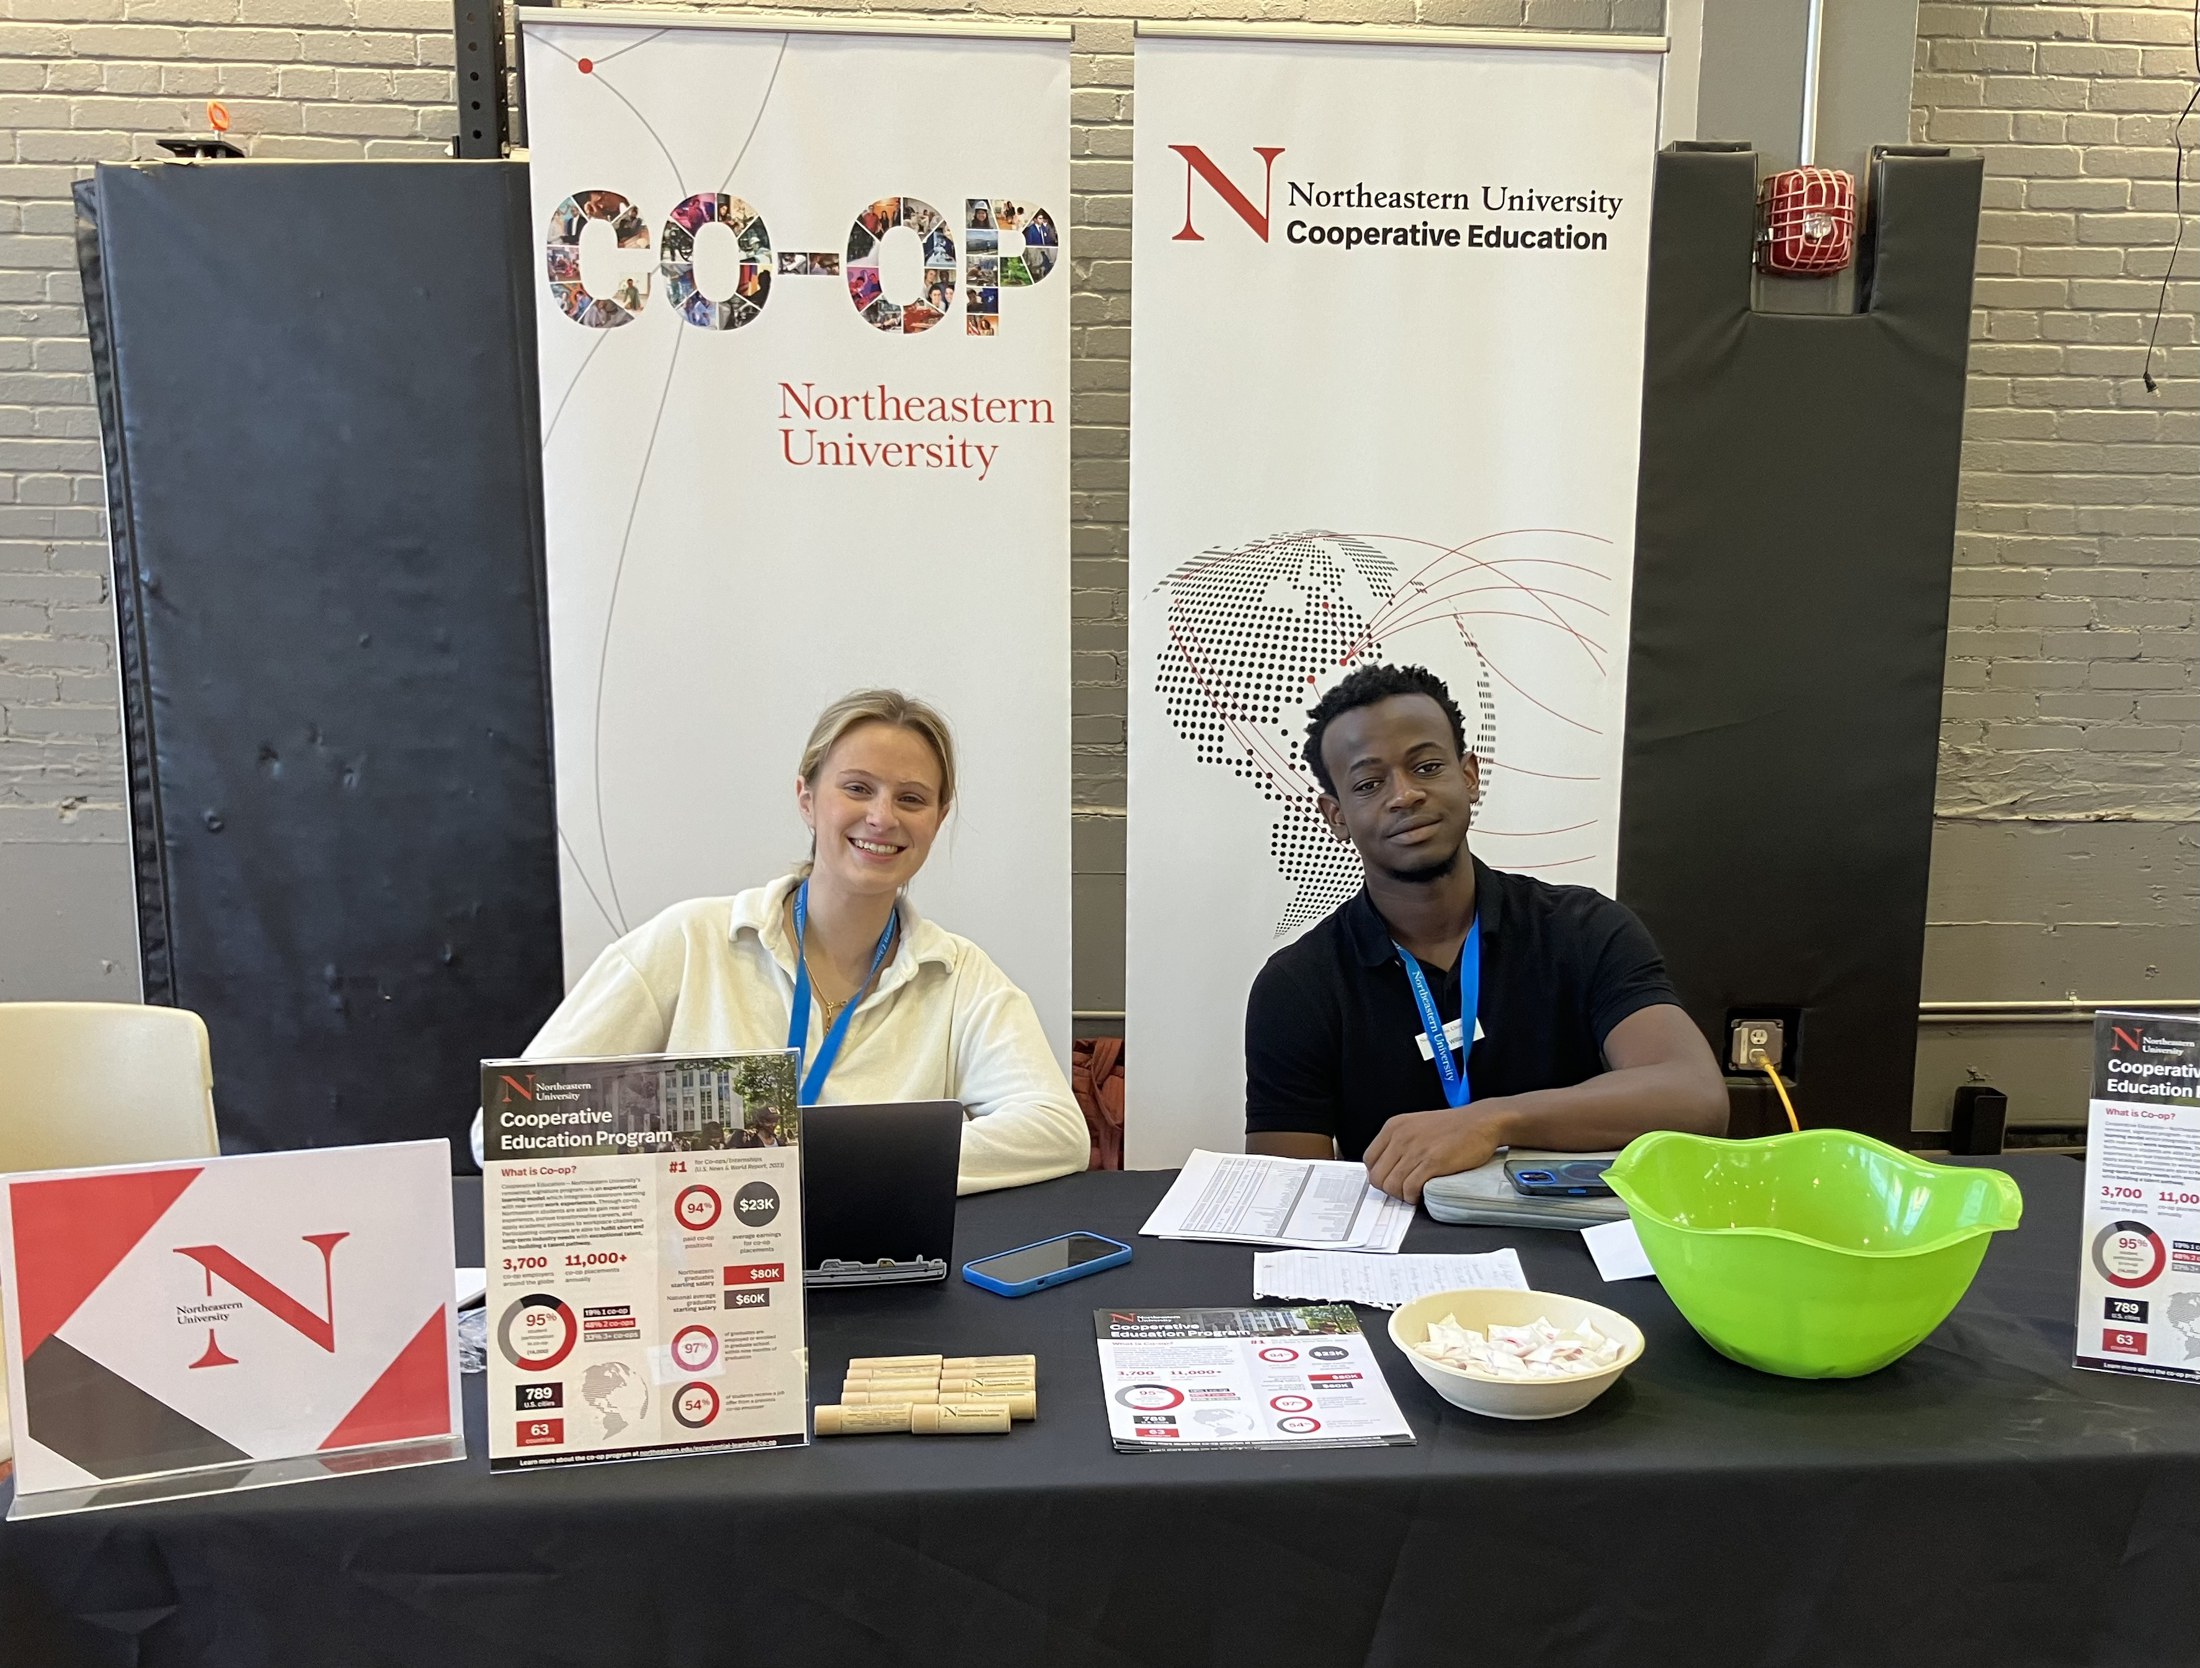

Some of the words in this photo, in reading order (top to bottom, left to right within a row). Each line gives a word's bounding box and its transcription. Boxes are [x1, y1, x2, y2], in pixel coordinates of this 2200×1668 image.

[1167, 144, 1286, 243] N
[1287, 181, 1469, 211] Northeastern
[1482, 186, 1624, 220] University
[1286, 220, 1461, 250] Cooperative
[1468, 224, 1607, 251] Education
[546, 190, 1059, 336] CO-OP
[777, 382, 1055, 424] Northeastern
[779, 428, 999, 482] University
[1412, 971, 1438, 1033] Northeastern
[1434, 1033, 1455, 1082] University
[2111, 1026, 2144, 1052] N
[2142, 1045, 2184, 1056] University
[500, 1074, 536, 1103] N
[536, 1082, 592, 1091] Northeastern
[2107, 1078, 2193, 1098] Education
[536, 1093, 580, 1102] University
[500, 1108, 613, 1129] Cooperative
[2106, 1108, 2129, 1116] What
[2131, 1109, 2139, 1117] is
[2141, 1111, 2176, 1121] Co-op?
[500, 1131, 593, 1150] Education
[596, 1130, 673, 1147] Program
[501, 1168, 527, 1177] What
[529, 1166, 538, 1176] is
[540, 1165, 577, 1176] Co-op?
[669, 1161, 687, 1173] #1
[2101, 1186, 2142, 1200] 3,700
[687, 1202, 712, 1214] 94%
[739, 1198, 775, 1213] $23K
[2119, 1237, 2148, 1250] 95%
[502, 1256, 548, 1272] 3,700
[564, 1252, 628, 1268] 11,000+
[750, 1268, 780, 1281] $80K
[735, 1293, 766, 1306] $60K
[176, 1302, 243, 1315] Northeastern
[2114, 1302, 2139, 1314] 789
[177, 1313, 230, 1325] University
[526, 1313, 557, 1327] 95%
[603, 1320, 608, 1328] 2
[1109, 1323, 1200, 1331] Cooperative
[1110, 1330, 1186, 1338] Education
[1188, 1329, 1251, 1337] Program
[2116, 1334, 2134, 1345] 63
[684, 1342, 708, 1354] 97%
[525, 1387, 553, 1400] 789
[524, 1401, 537, 1409] U.S.
[685, 1399, 711, 1411] 54%
[530, 1423, 549, 1436] 63
[519, 1458, 538, 1466] Learn
[538, 1457, 555, 1465] more
[556, 1455, 574, 1463] about
[575, 1454, 586, 1462] the
[586, 1453, 605, 1462] co-op
[605, 1451, 632, 1460] program
